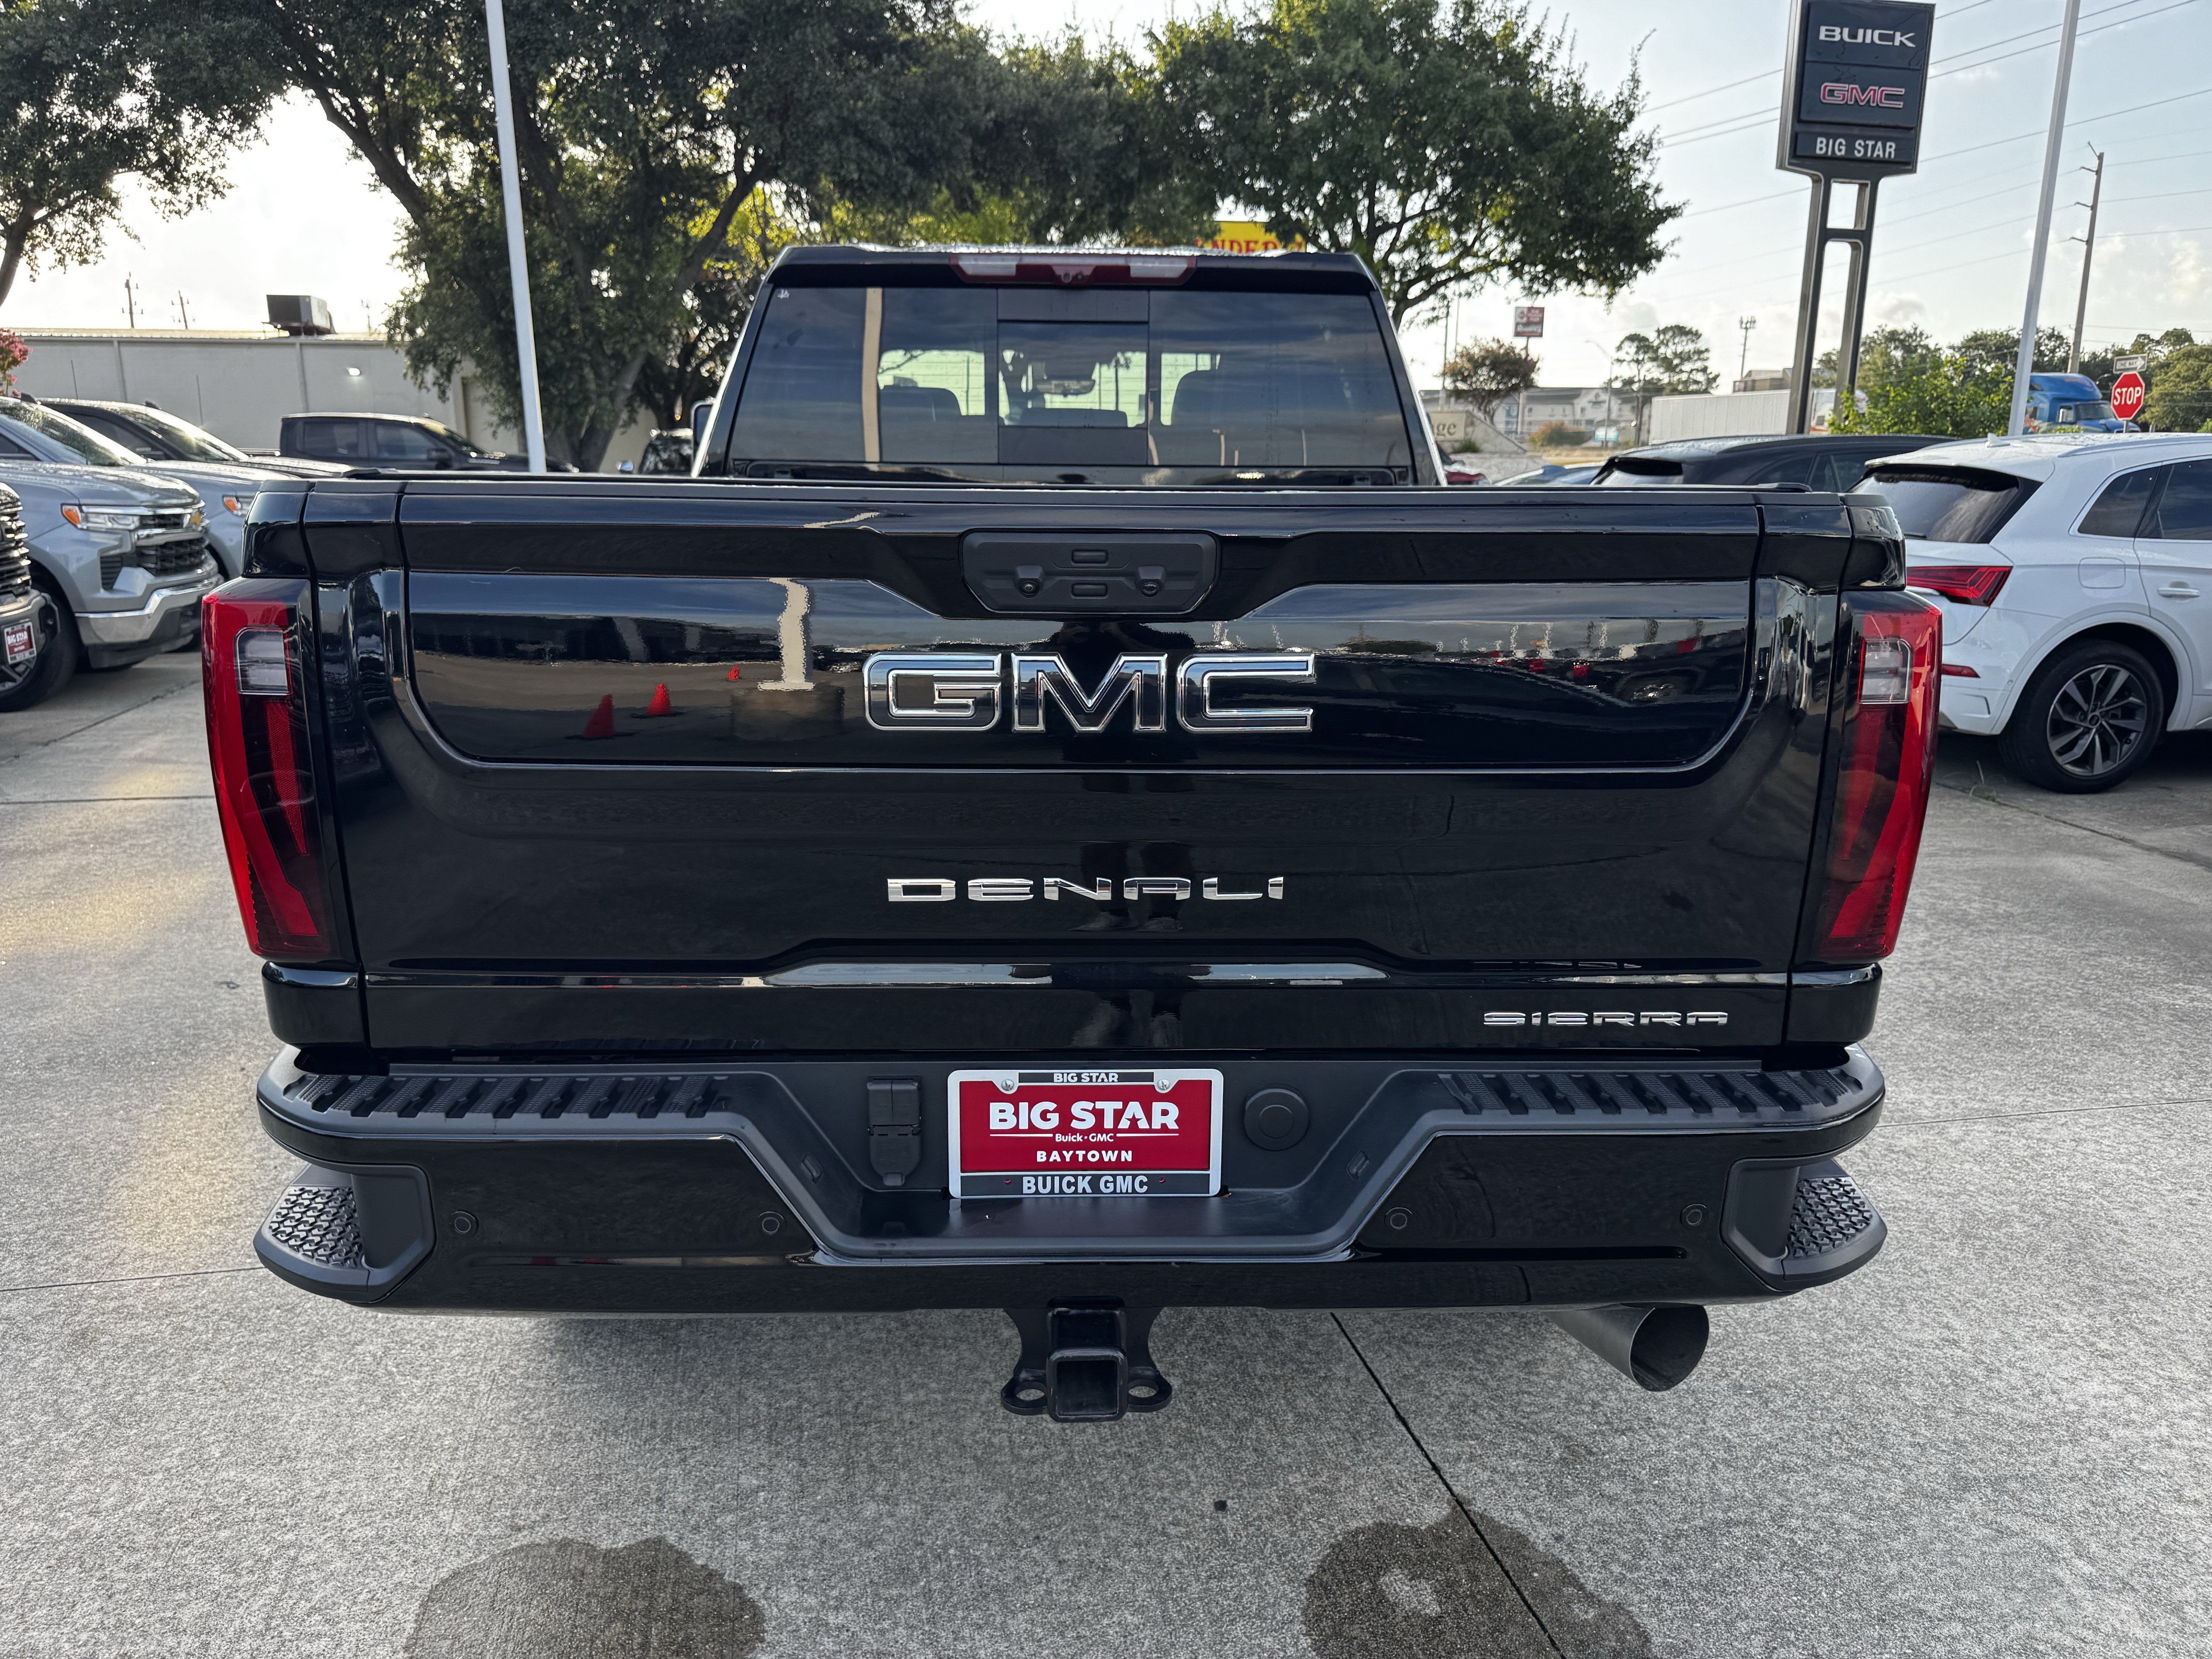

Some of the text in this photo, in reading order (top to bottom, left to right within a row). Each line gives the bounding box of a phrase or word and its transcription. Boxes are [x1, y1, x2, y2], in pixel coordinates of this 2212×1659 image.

[1819, 26, 1916, 47] BUICK
[1820, 82, 1905, 108] GMC
[1815, 137, 1896, 158] BIG STAR
[2113, 387, 2142, 405] STOP
[862, 651, 1314, 733] GMC
[887, 877, 1284, 902] DENALI
[1483, 1011, 1728, 1026] SIERRA
[1053, 1072, 1118, 1082] BIG STAR
[990, 1101, 1179, 1130] BIG STAR
[1037, 1150, 1132, 1162] BAYTOWN
[1023, 1175, 1148, 1194] BUICK GMC
